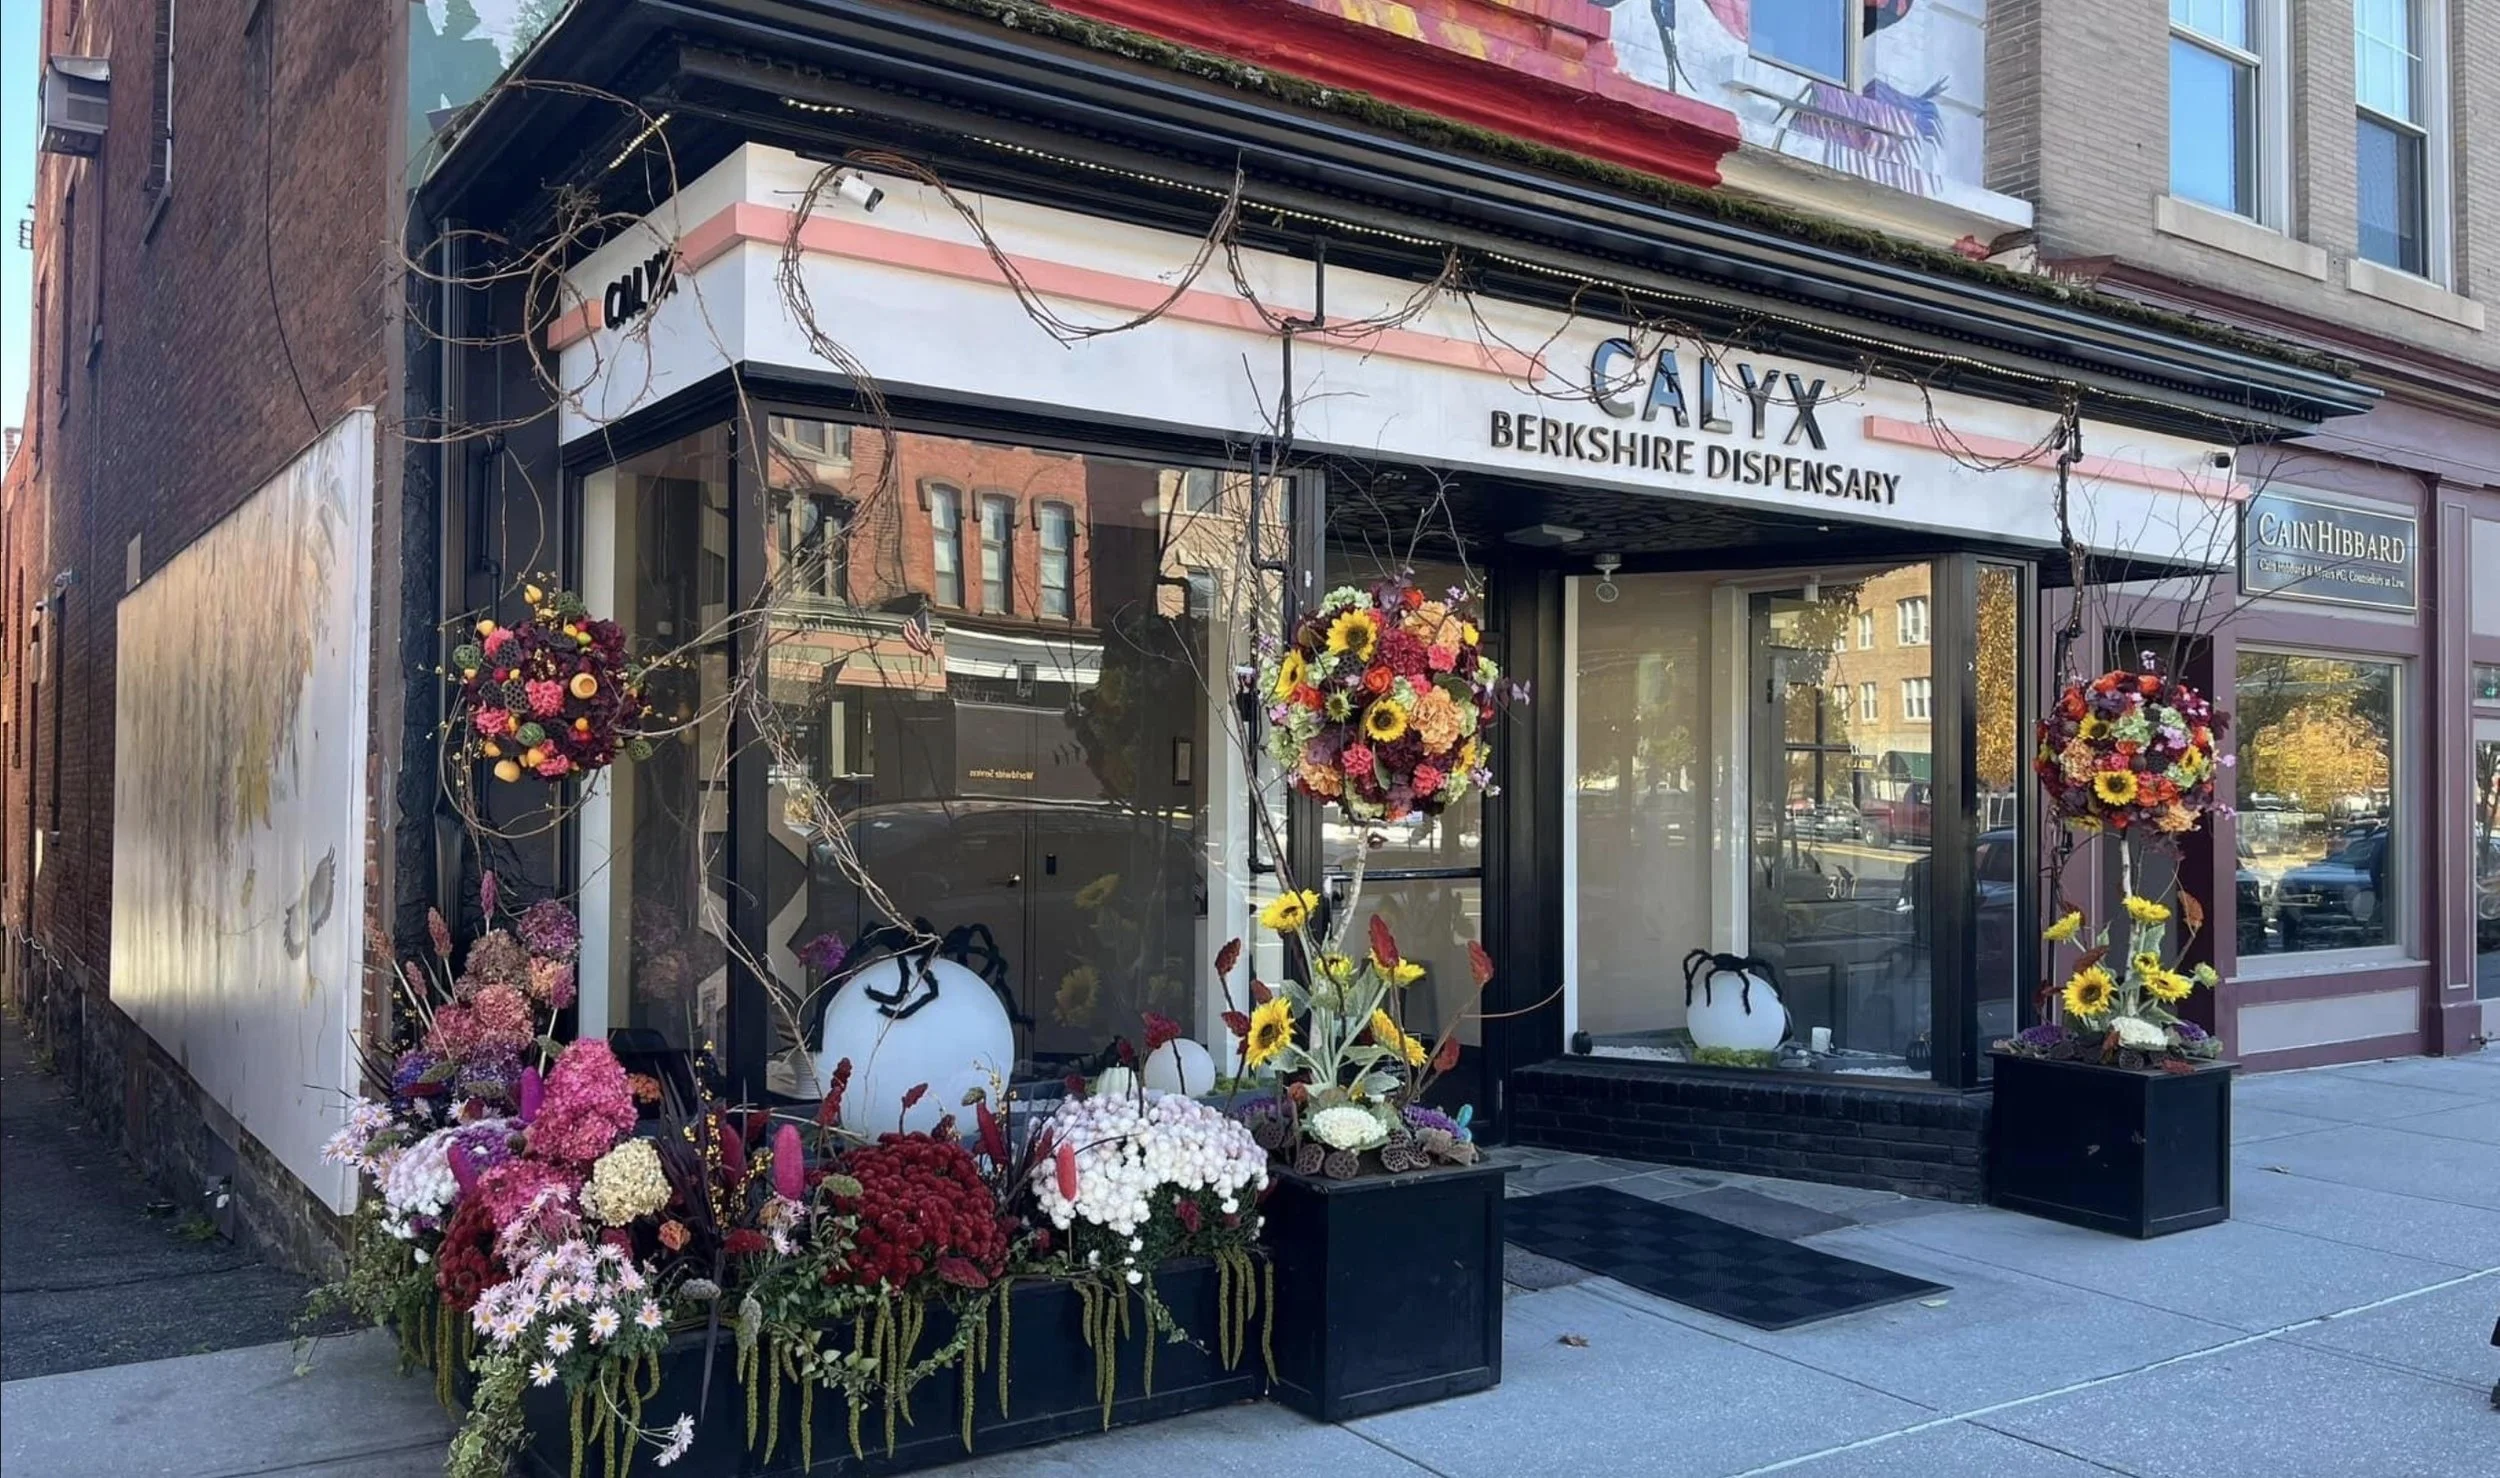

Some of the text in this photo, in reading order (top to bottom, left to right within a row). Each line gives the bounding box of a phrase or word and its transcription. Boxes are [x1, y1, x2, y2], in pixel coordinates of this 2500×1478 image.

[1592, 336, 1827, 450] CALYX
[1490, 409, 1902, 506] BERKSHIRE DISPENSARY
[1826, 875, 1857, 899] 307
